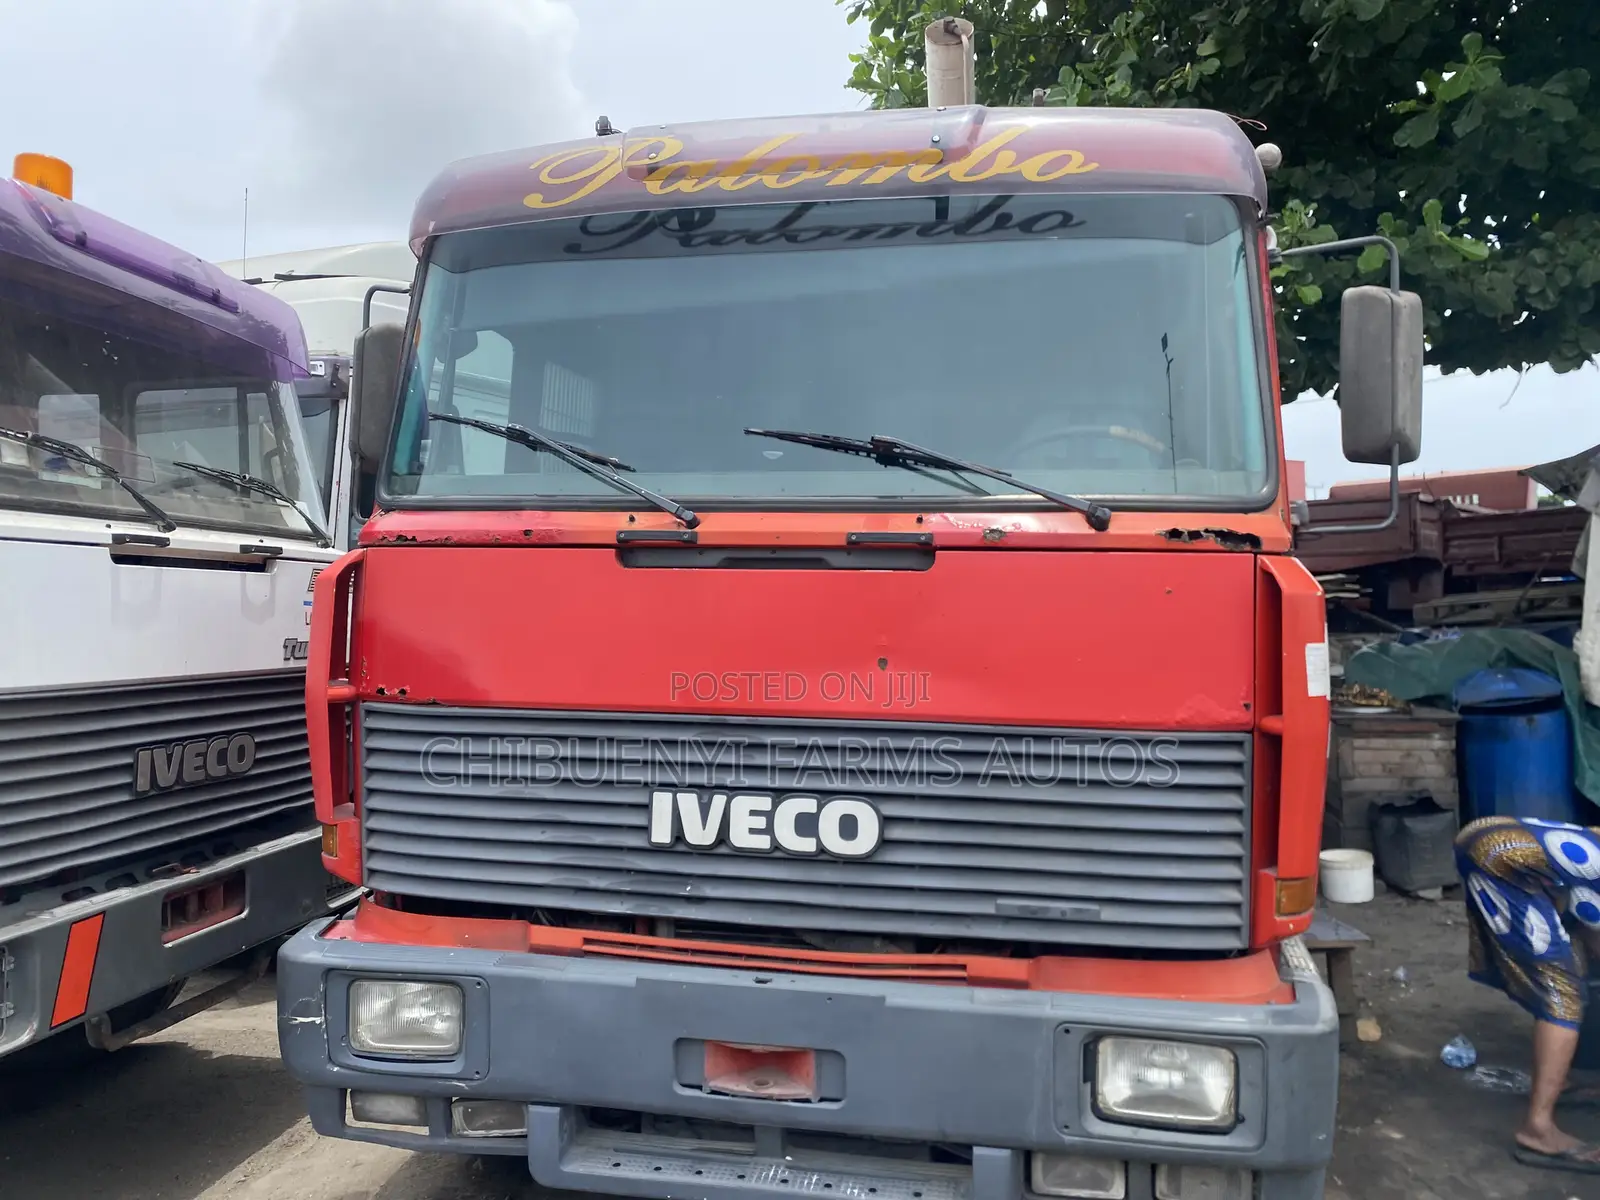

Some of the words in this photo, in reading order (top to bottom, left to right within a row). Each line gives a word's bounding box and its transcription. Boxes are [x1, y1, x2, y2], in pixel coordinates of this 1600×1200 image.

[523, 126, 1099, 209] Palombo
[136, 733, 256, 792] IVECO
[649, 790, 881, 857] IVECO
